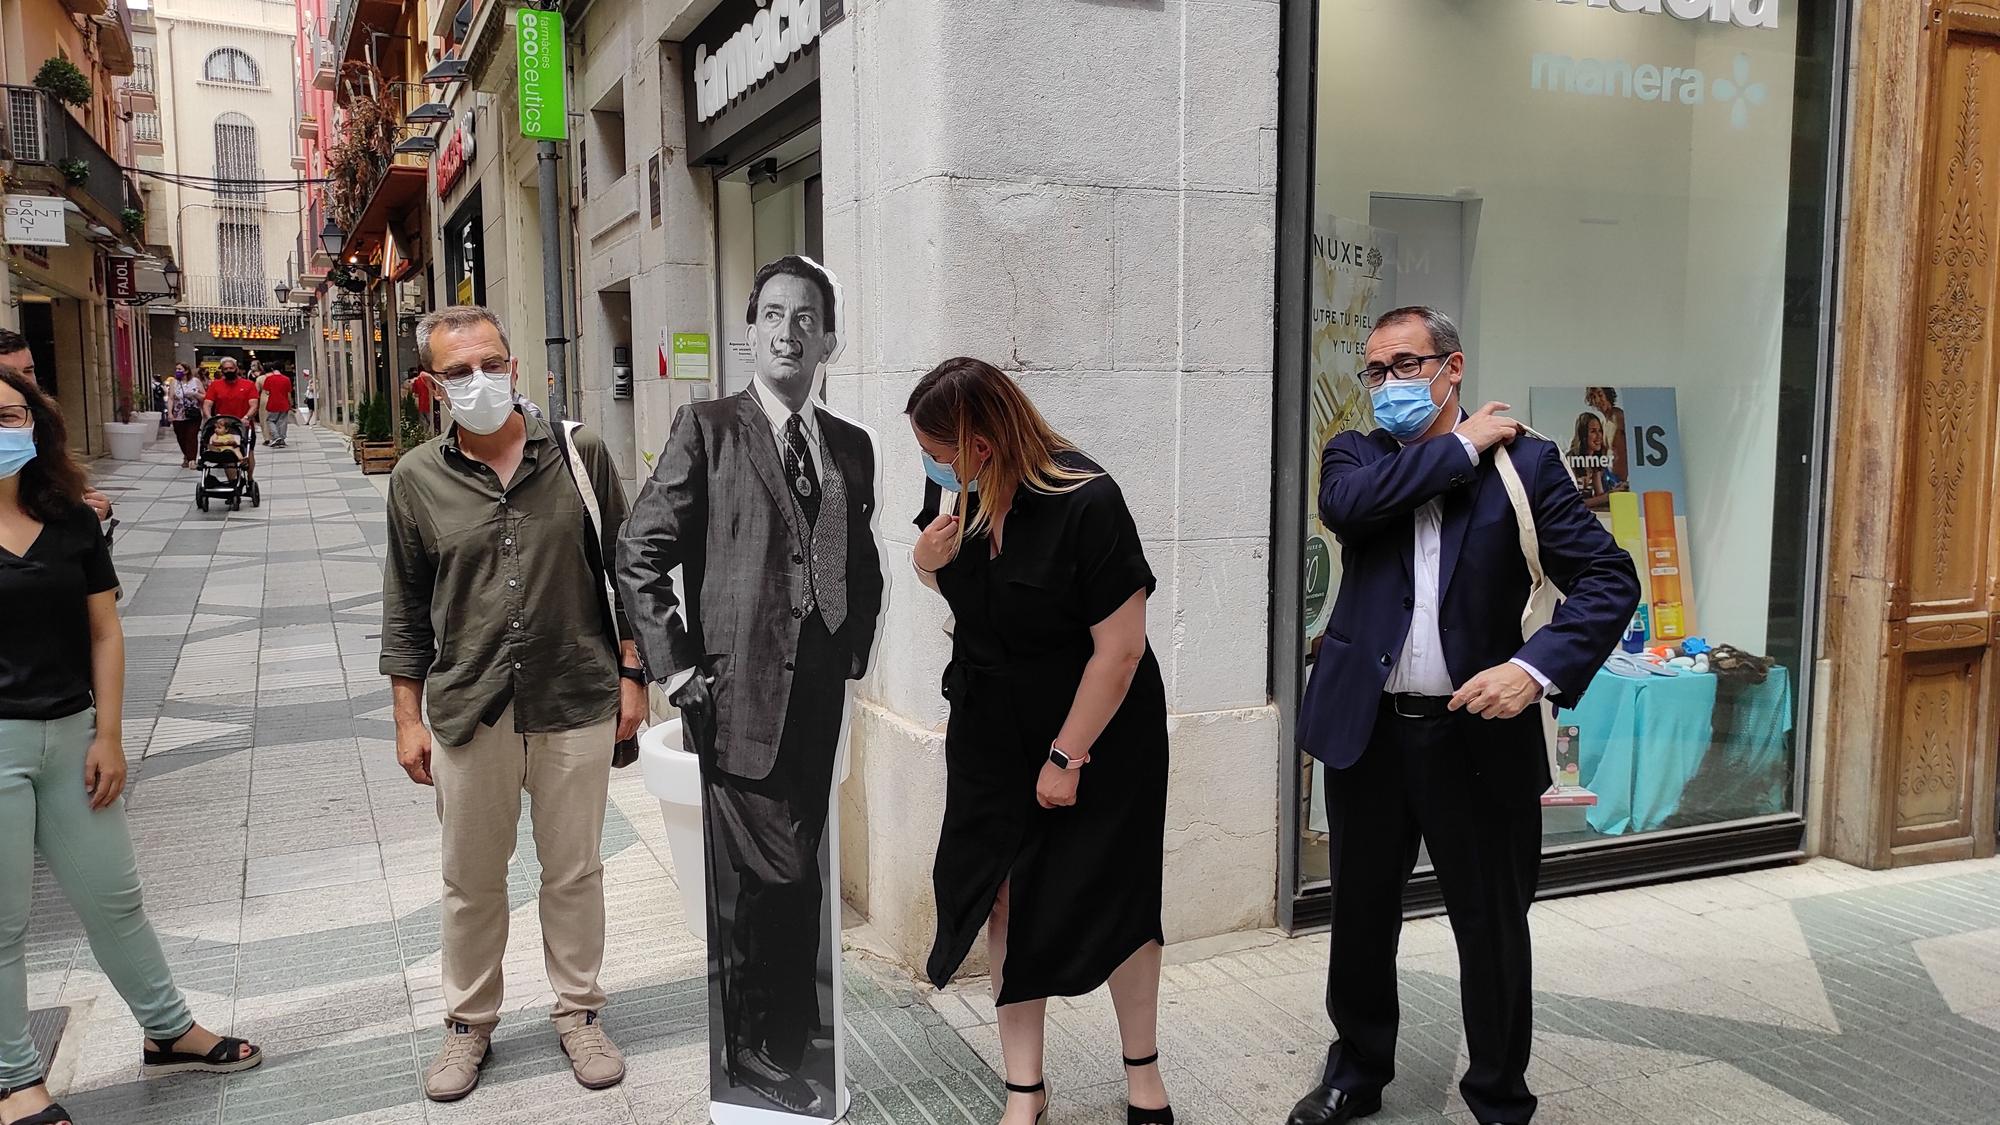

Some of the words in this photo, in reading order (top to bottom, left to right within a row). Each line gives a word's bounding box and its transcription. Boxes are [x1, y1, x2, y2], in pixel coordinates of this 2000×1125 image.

[522, 13, 544, 133] ecoceutics
[1531, 54, 1705, 105] manera
[5, 207, 62, 218] GANT
[19, 199, 34, 234] GANT
[1313, 233, 1363, 268] NUXE
[116, 261, 130, 295] FAJOL
[1313, 309, 1336, 324] UTRE
[1340, 312, 1350, 325] TU
[1354, 316, 1372, 329] PIEL
[1333, 341, 1338, 351] Y
[1341, 341, 1352, 354] TU
[1634, 425, 1669, 467] IS
